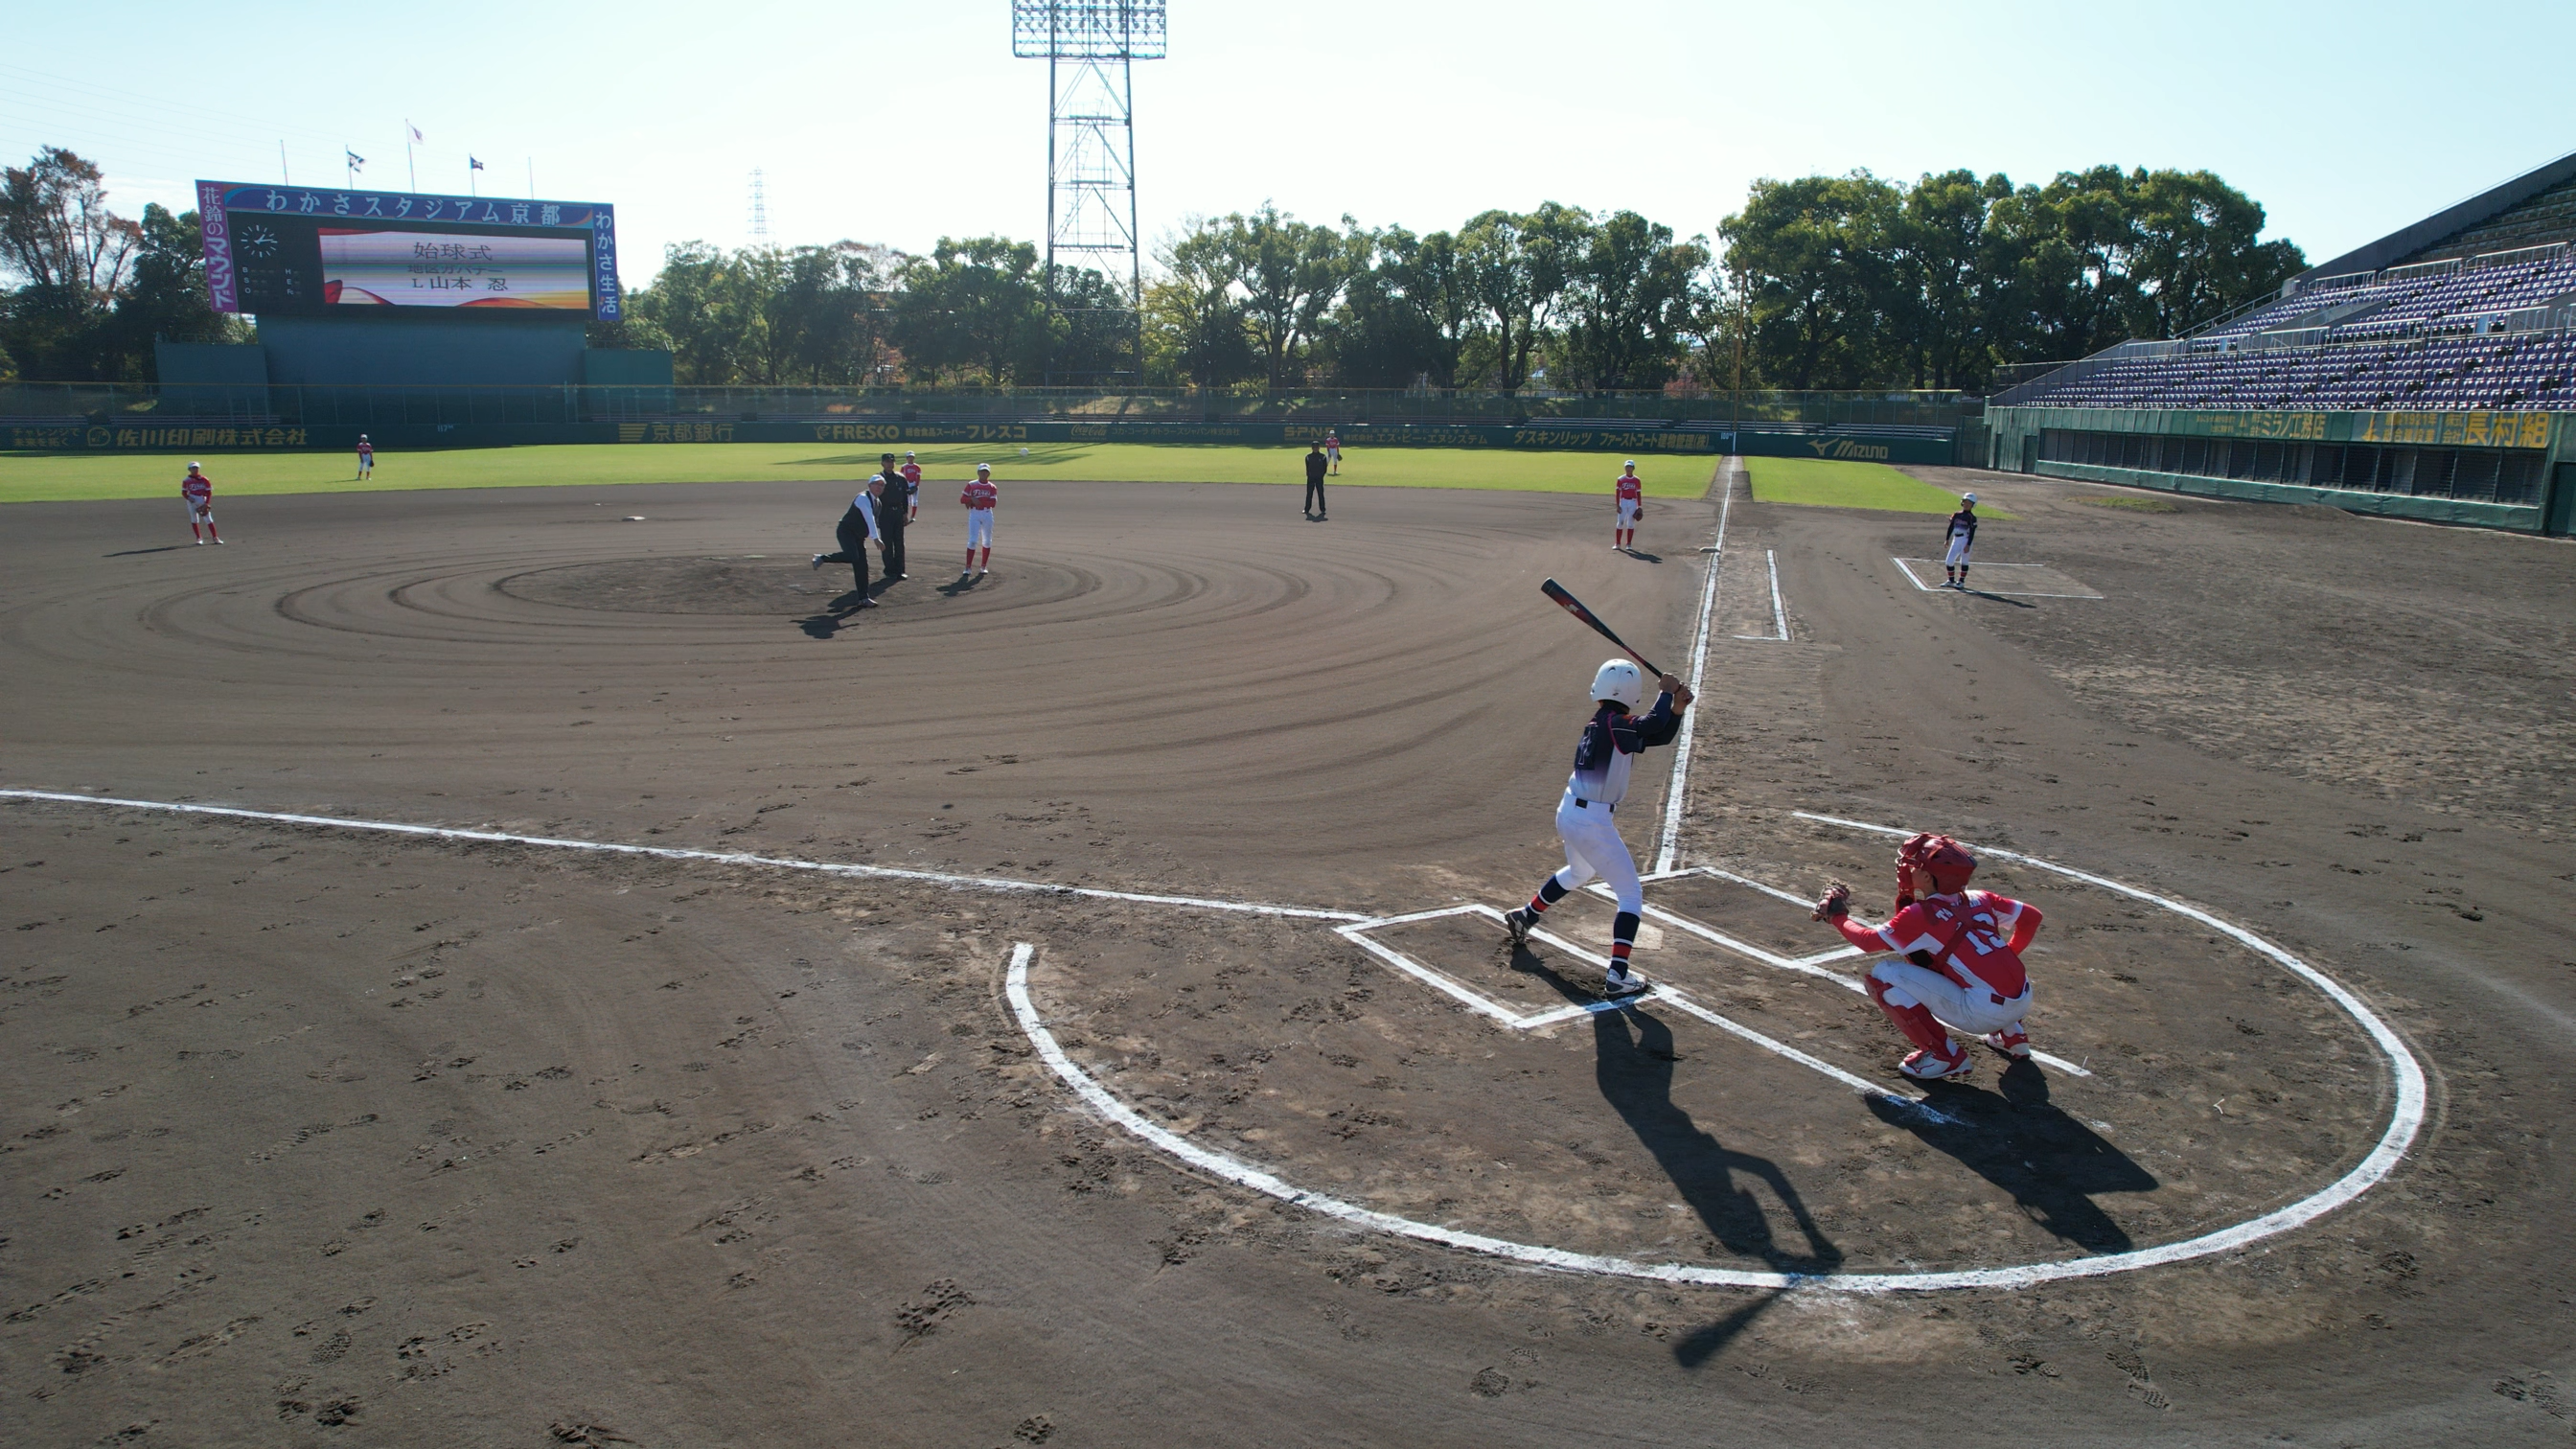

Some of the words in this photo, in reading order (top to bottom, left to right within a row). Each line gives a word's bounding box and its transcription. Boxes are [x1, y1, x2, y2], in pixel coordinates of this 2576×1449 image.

[266, 189, 561, 226] わかさスタジアム京都
[201, 186, 233, 309] 花鈴のマウンド
[414, 242, 493, 261] 始球式
[595, 211, 617, 314] わかさ生活
[429, 276, 472, 290] 山本
[652, 423, 734, 442] 京都銀行
[832, 425, 900, 440] FRESCO
[2261, 413, 2327, 440] ミラノ工務店
[2464, 412, 2550, 448] 長村組
[116, 427, 308, 447] 佐川印刷株式会社
[1513, 429, 1593, 446] ダスキンリッツ
